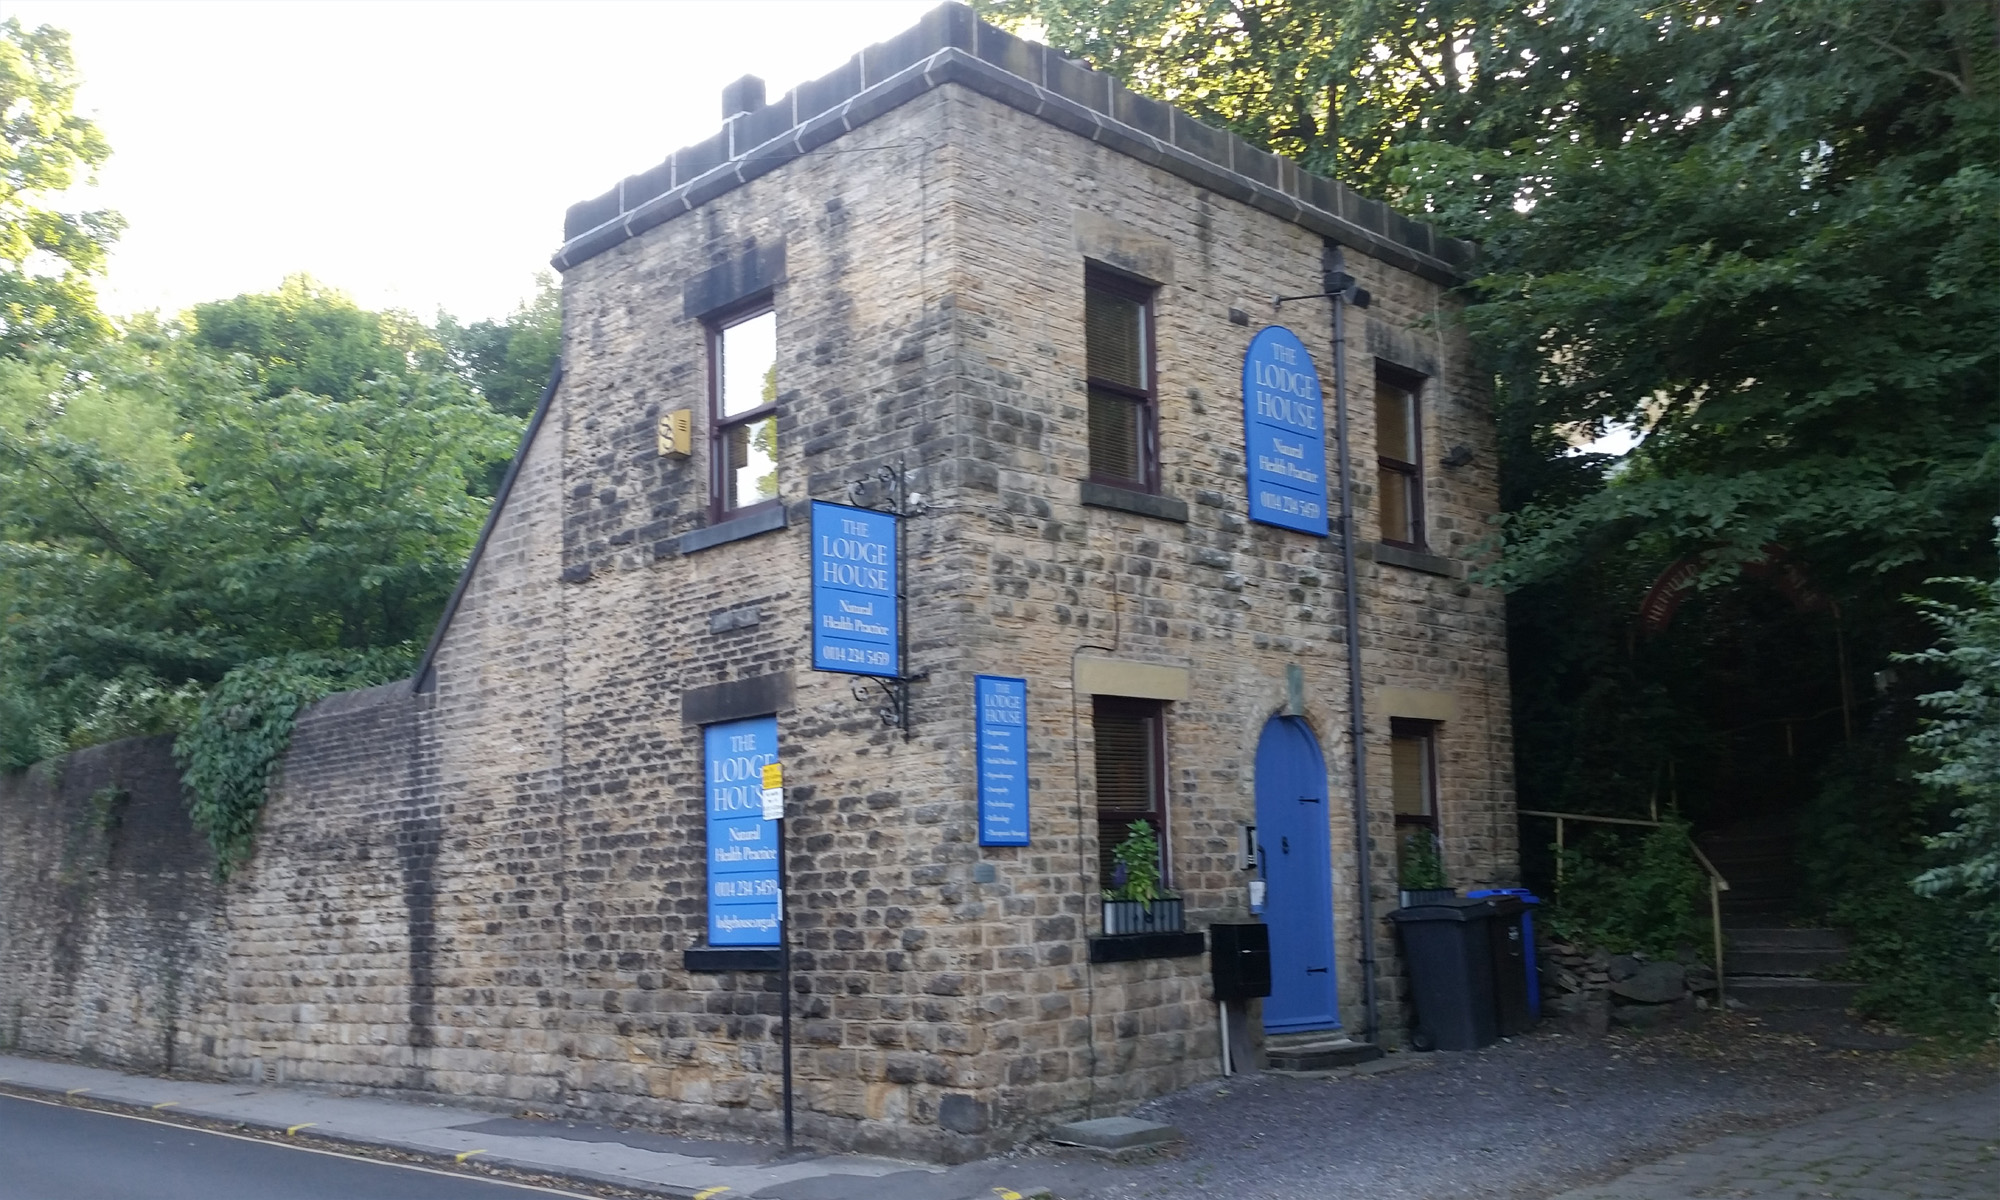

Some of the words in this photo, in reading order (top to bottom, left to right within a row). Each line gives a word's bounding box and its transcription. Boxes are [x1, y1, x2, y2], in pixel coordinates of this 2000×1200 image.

[1271, 342, 1297, 366] THE
[1255, 360, 1316, 401] LODGE
[1256, 390, 1318, 431] HOUSE
[1259, 455, 1287, 476] Health
[1287, 462, 1319, 484] Practice
[1260, 491, 1282, 511] 0114
[841, 518, 869, 537] THE
[822, 535, 888, 565] LODGE
[822, 561, 889, 590] HOUSE
[839, 599, 873, 616] Natural
[823, 614, 854, 631] Health
[855, 620, 890, 636] Practice
[822, 645, 847, 662] 0114
[847, 648, 865, 664] 234
[984, 694, 1021, 709] LODGE
[984, 708, 1022, 724] HOUSE
[729, 734, 756, 752] THE
[713, 783, 763, 812] HOUS
[729, 824, 761, 841] Natural
[715, 846, 742, 862] Health
[743, 845, 777, 861] Practice
[714, 881, 735, 897] 0114
[736, 880, 753, 896] 234
